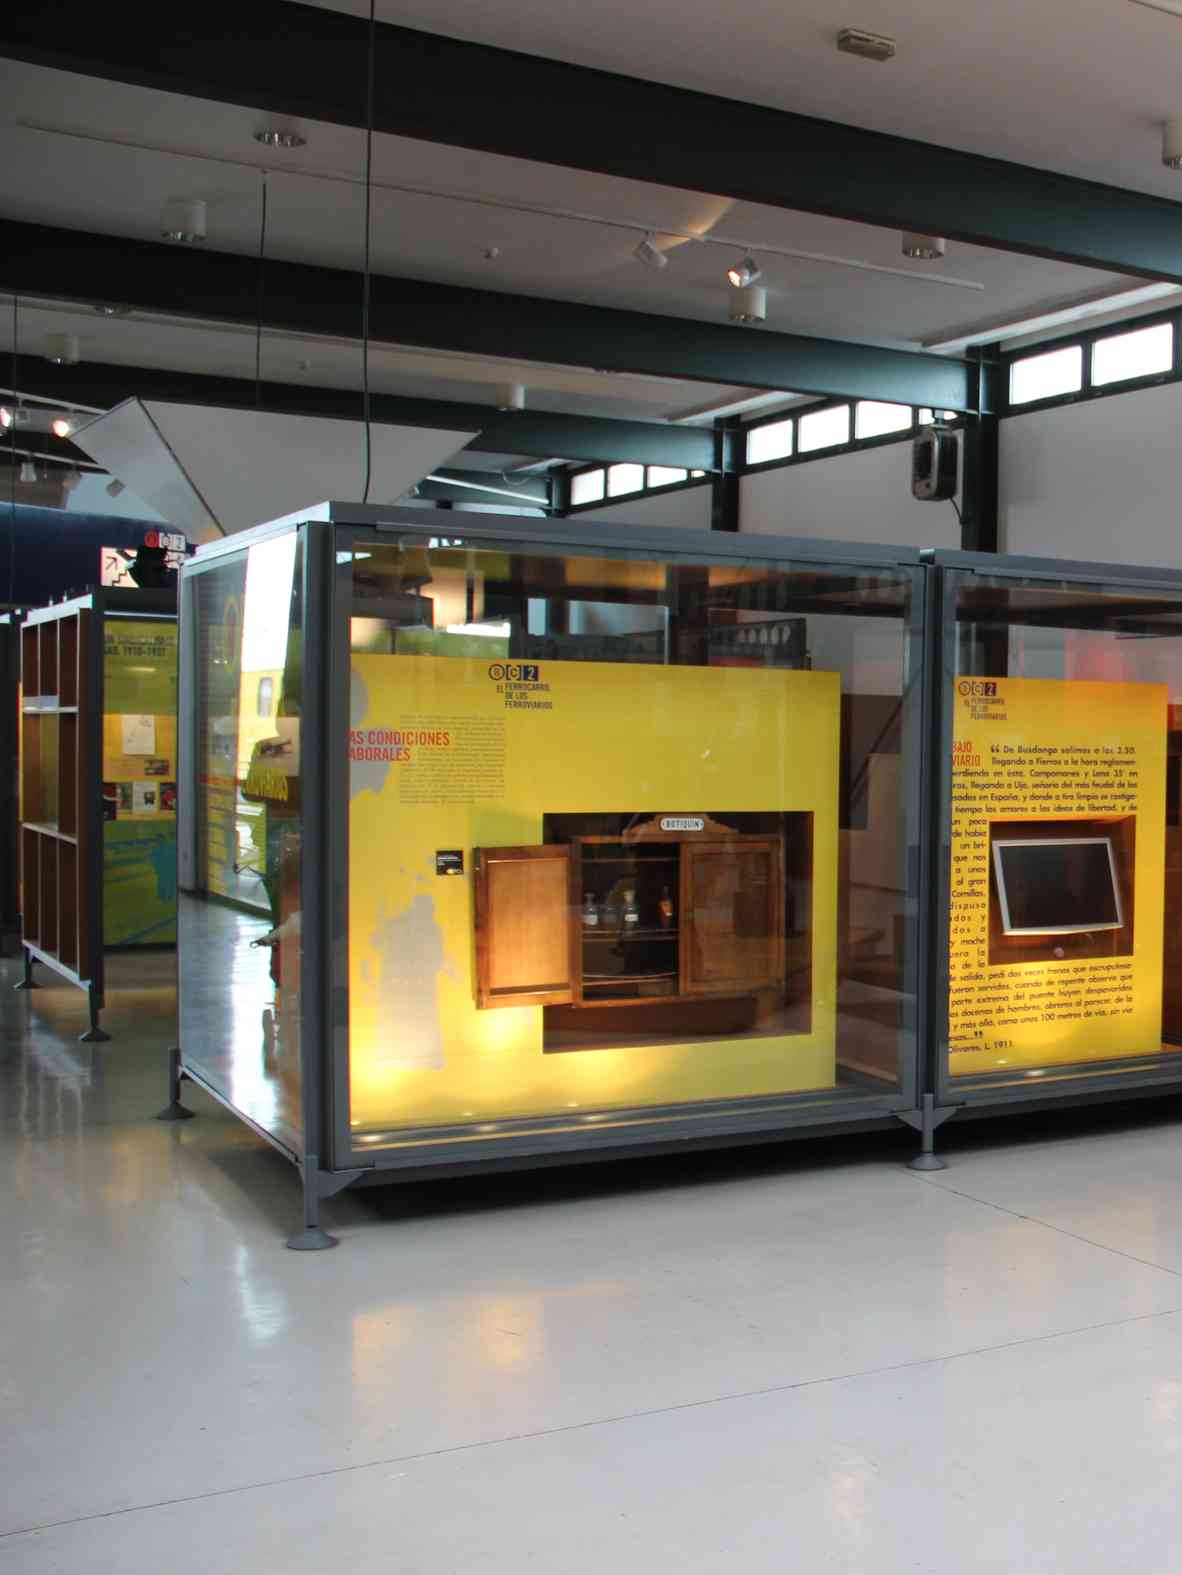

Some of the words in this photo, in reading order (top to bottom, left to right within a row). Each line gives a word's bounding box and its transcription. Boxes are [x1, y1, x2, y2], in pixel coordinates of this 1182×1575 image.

[367, 730, 450, 747] CONDICIONES
[991, 757, 1026, 767] llegando
[1080, 757, 1098, 766] hora
[1029, 792, 1053, 800] donde
